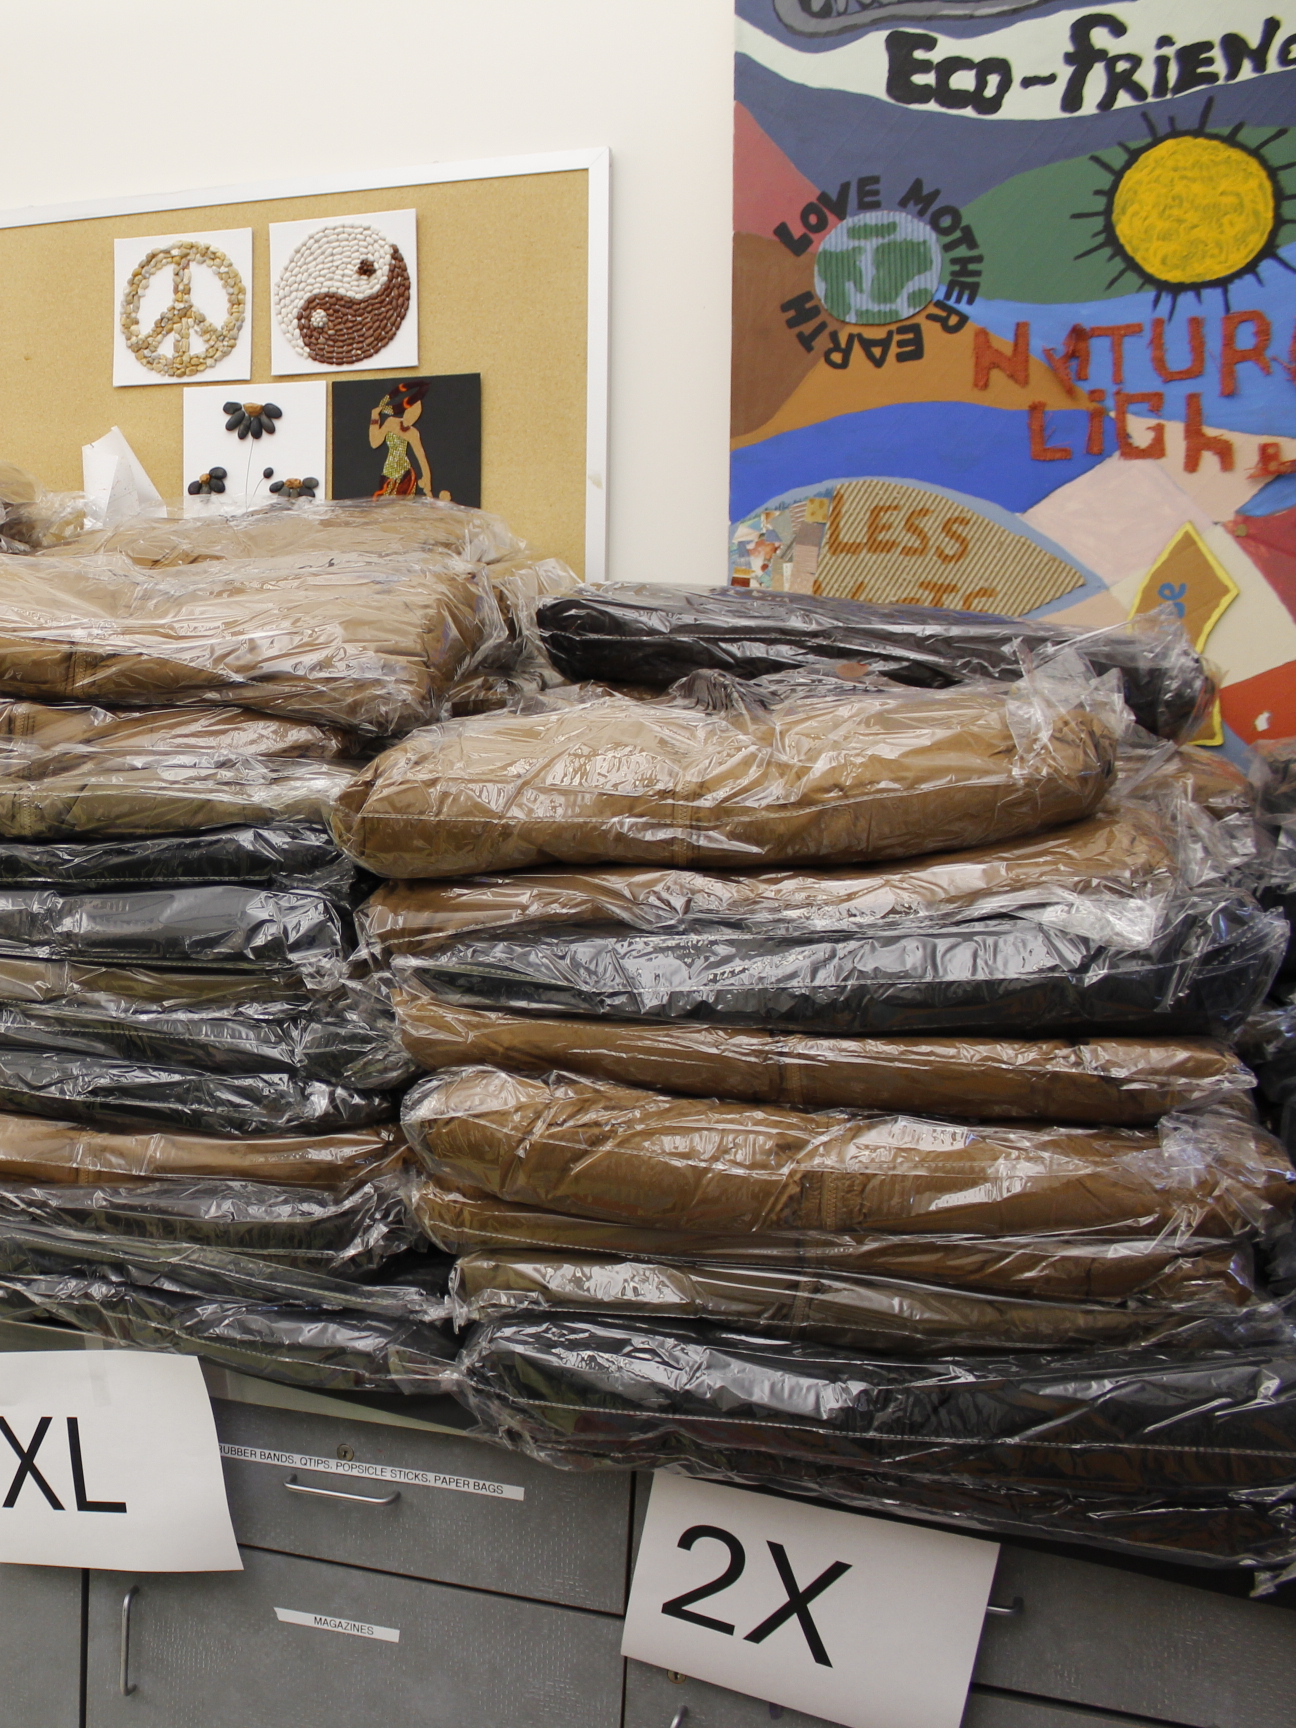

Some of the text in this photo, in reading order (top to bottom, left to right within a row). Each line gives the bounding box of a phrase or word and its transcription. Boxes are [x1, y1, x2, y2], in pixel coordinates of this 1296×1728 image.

[773, 175, 984, 371] LOVE MOTHER EARTH
[827, 490, 970, 565] LESS
[335, 1462, 388, 1478] POPSICLE
[434, 1475, 471, 1490] PAPER
[473, 1481, 504, 1495] BAGS
[313, 1615, 374, 1636] MAGAZINES
[661, 1524, 853, 1668] 2X
